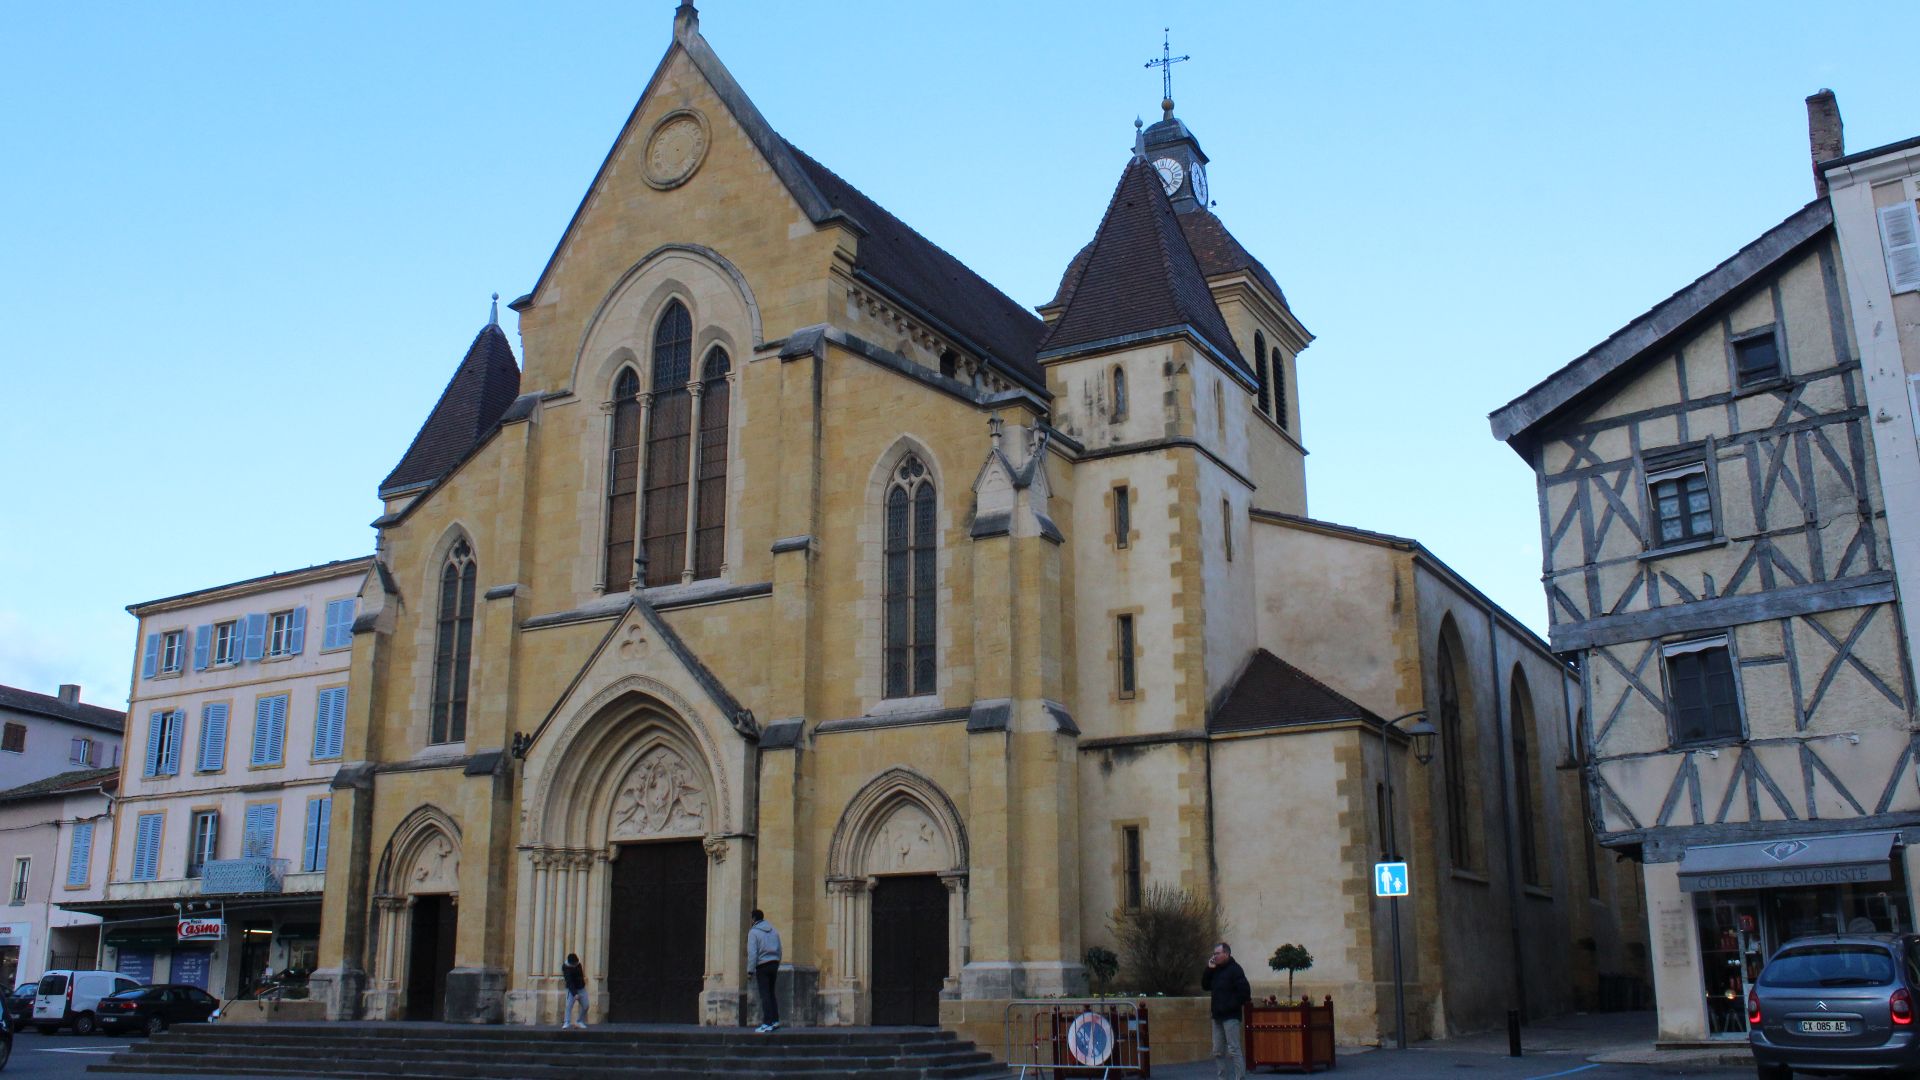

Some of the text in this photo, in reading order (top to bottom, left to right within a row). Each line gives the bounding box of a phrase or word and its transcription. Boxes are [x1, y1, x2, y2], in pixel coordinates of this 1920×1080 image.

[1697, 867, 1869, 889] COIFFURE COLORISTE
[177, 921, 220, 937] Casino
